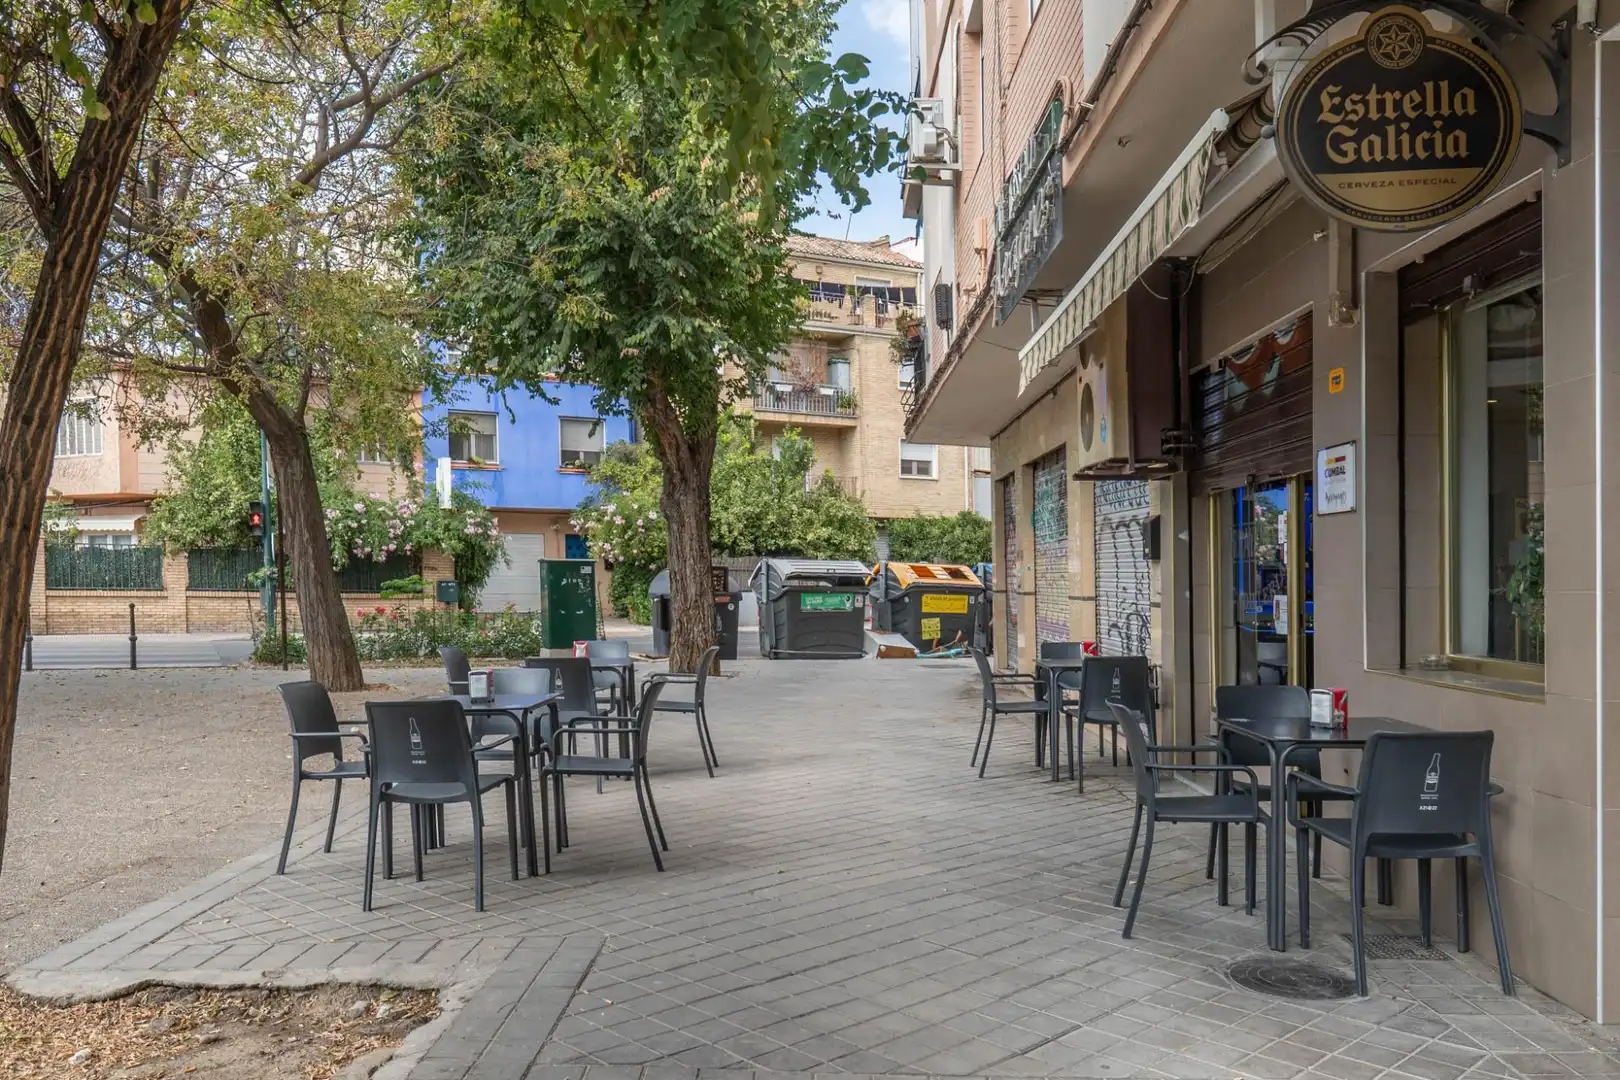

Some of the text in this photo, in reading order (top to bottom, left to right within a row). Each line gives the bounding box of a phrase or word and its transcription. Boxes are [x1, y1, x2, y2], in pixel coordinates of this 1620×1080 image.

[1316, 79, 1478, 124] Estrella
[1325, 120, 1471, 165] Galicia
[1338, 177, 1457, 190] CERVEZA ESPECIAL
